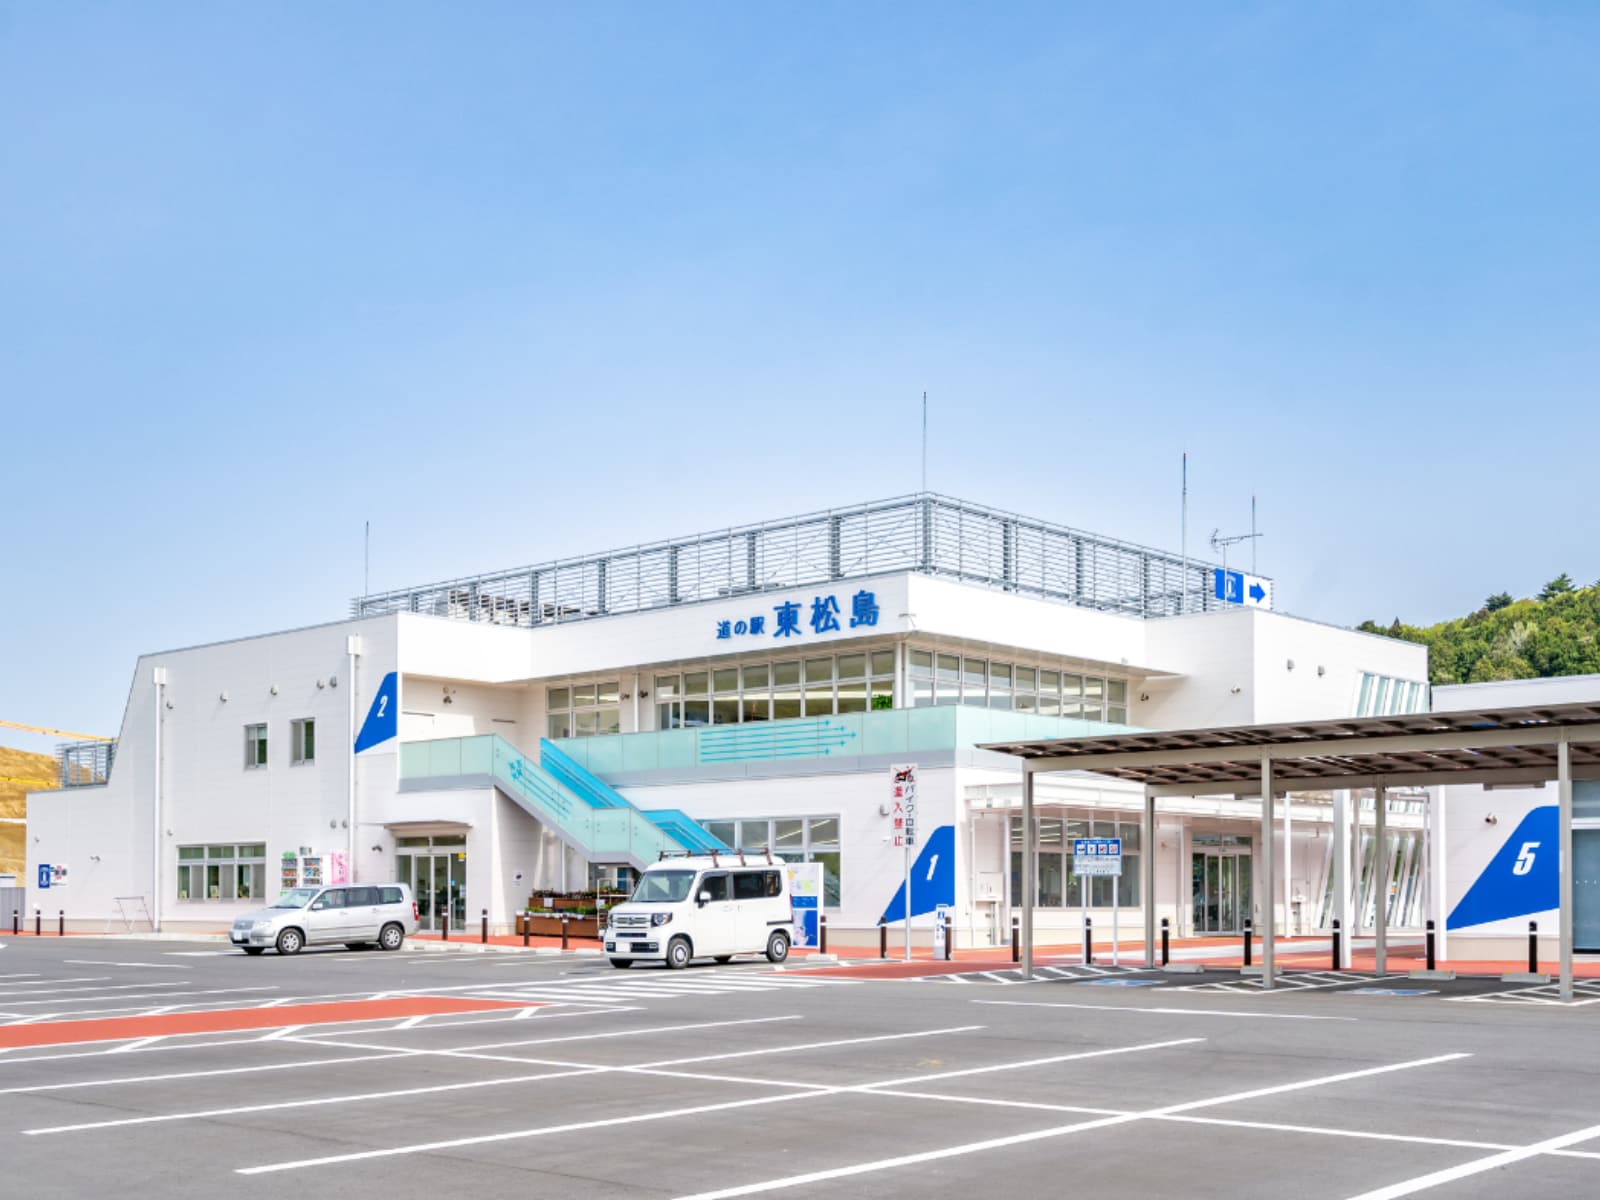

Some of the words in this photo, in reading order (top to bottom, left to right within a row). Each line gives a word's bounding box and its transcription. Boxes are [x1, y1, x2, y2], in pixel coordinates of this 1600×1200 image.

[716, 616, 765, 639] 道の駅
[772, 589, 881, 638] 東松島
[377, 694, 389, 718] 2
[926, 854, 939, 881] 1
[1512, 841, 1541, 876] 5
